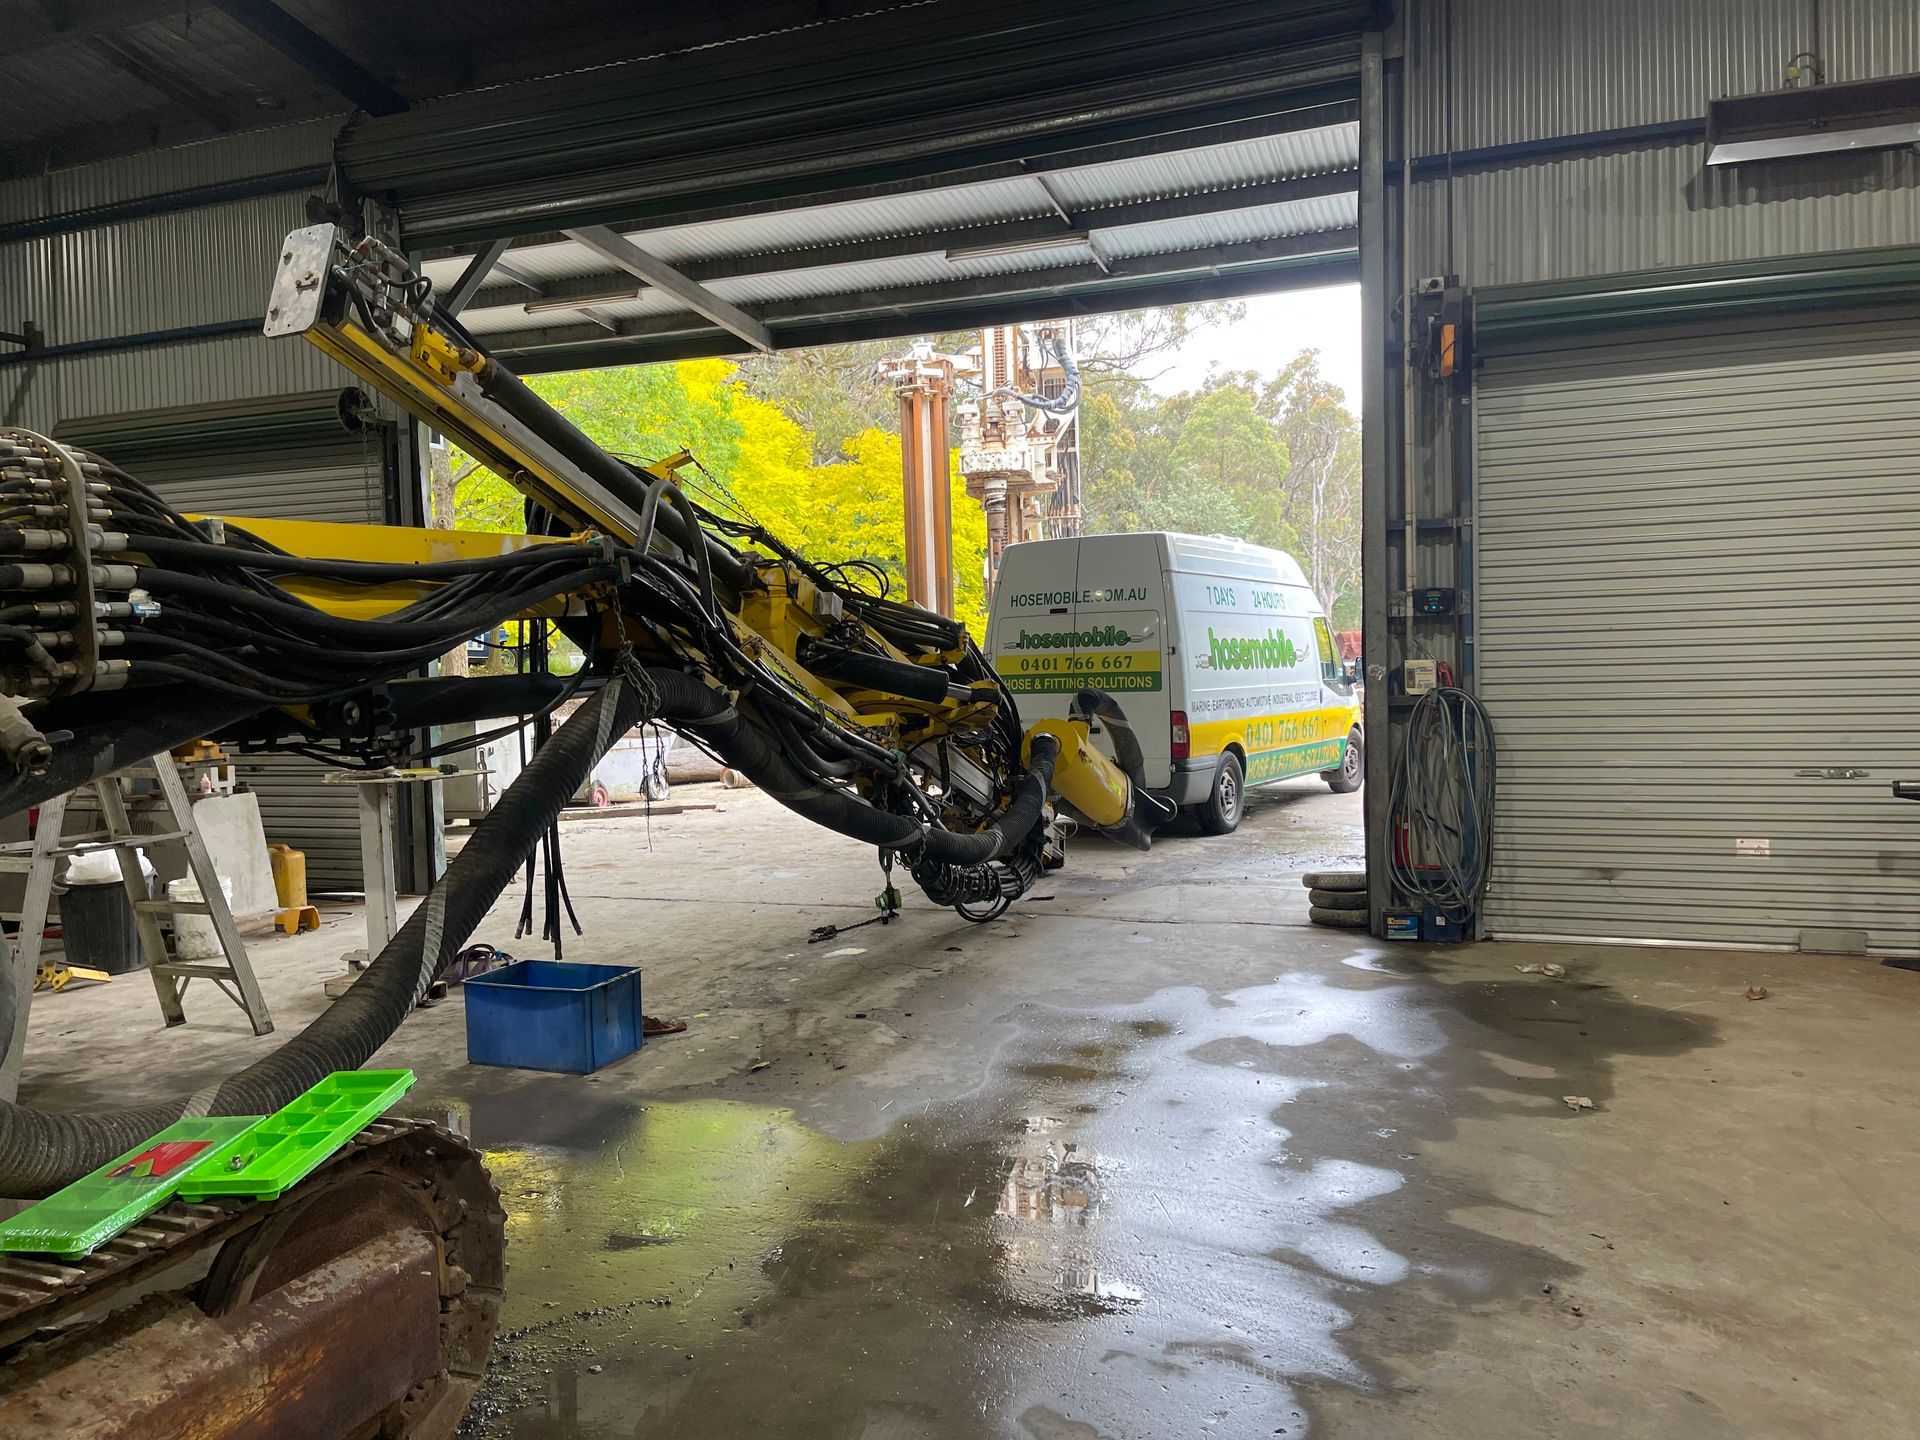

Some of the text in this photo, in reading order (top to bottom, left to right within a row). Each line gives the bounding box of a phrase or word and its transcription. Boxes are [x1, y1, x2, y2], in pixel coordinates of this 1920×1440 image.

[1206, 586, 1286, 610] 7 DAYS 24 HOURS
[1019, 626, 1127, 649] hosemobile
[1208, 627, 1295, 670] hosemobile
[1020, 655, 1133, 671] 0401 766 667
[1005, 676, 1153, 690] HOSE & FITTING SOLUTIONS
[1246, 715, 1319, 748] 0401 766 667
[1248, 758, 1270, 780] HOSE
